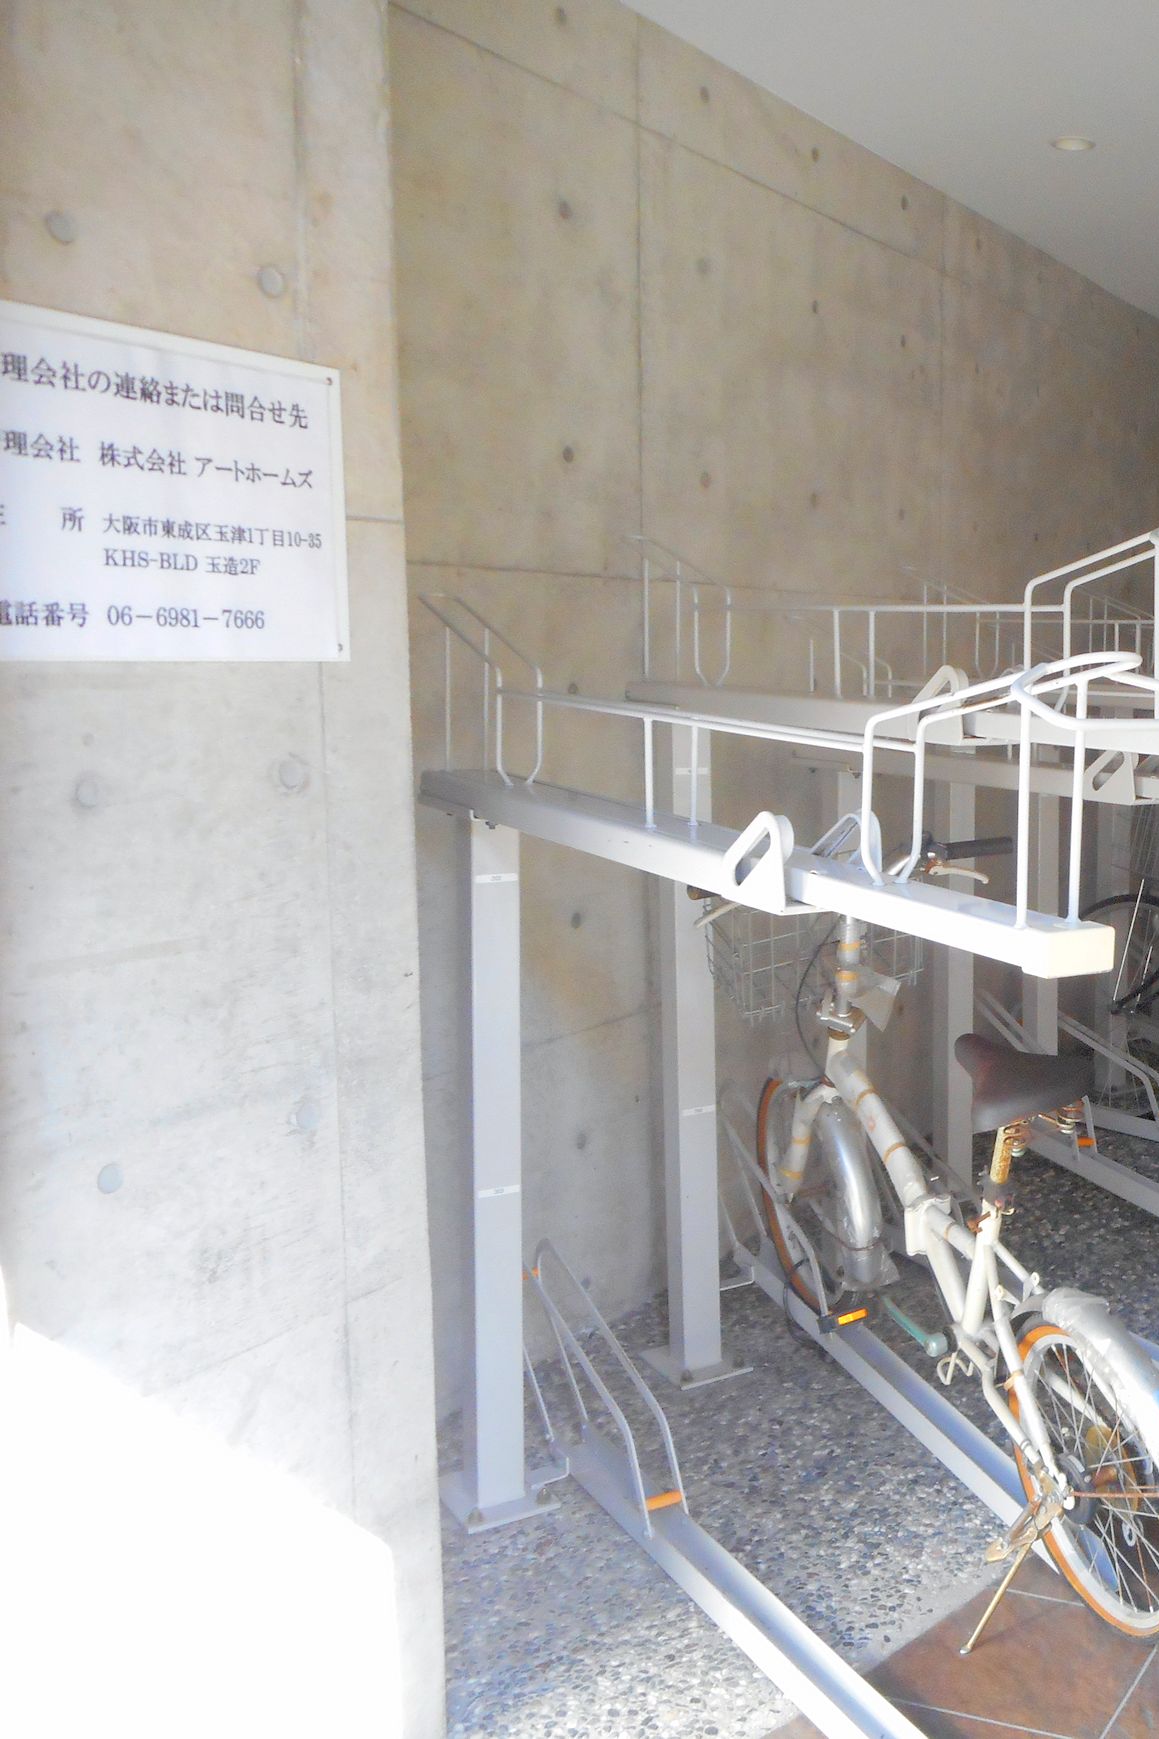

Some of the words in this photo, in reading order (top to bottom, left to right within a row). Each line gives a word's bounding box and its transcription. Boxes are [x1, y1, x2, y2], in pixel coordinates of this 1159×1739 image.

[99, 441, 187, 476] 株式会社
[194, 456, 313, 489] アートホームズ
[103, 548, 199, 572] KHS-BLD
[205, 556, 261, 576] 玉造2F
